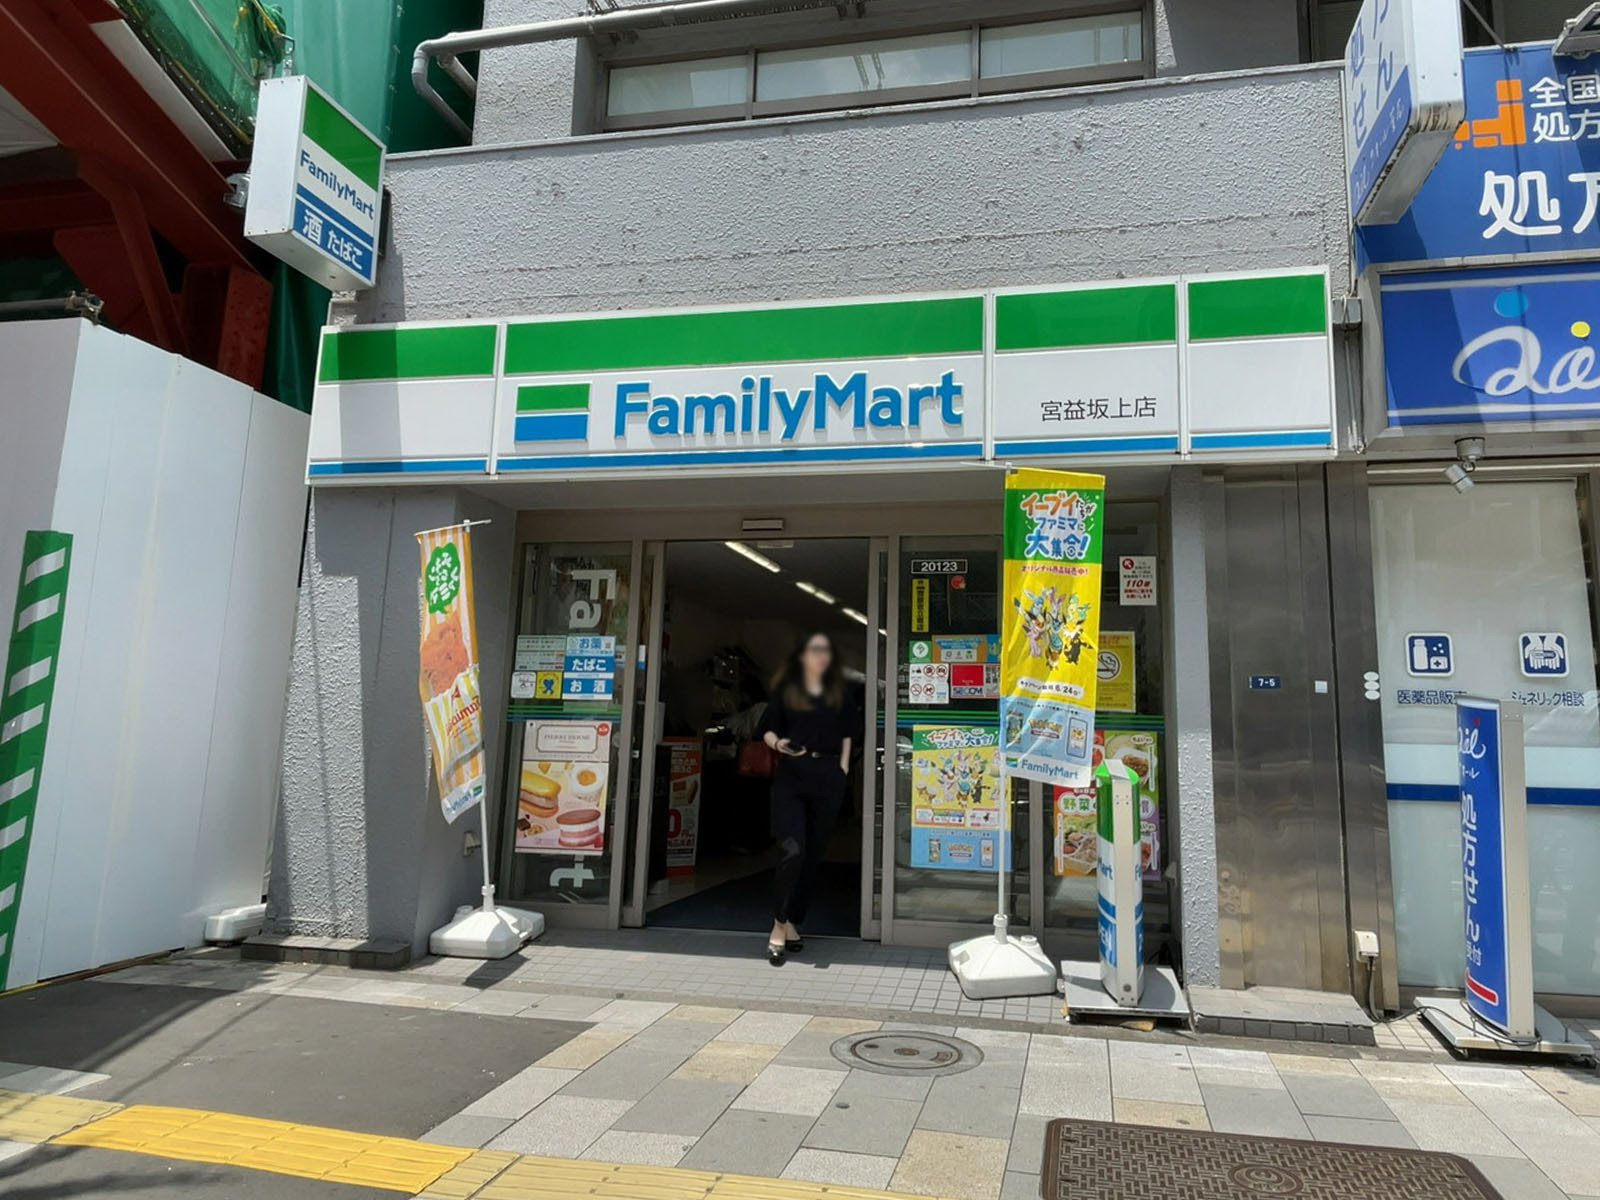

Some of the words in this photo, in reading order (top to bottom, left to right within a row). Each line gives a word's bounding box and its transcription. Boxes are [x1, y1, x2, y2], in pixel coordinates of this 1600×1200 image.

[300, 150, 375, 221] FamilyMart
[302, 209, 324, 246] 酒
[327, 230, 363, 270] たばこ
[614, 369, 964, 441] FamilyMart
[1040, 396, 1158, 422] 宮益坂上店
[920, 561, 958, 572] 20123
[572, 658, 607, 671] たばこ
[1397, 689, 1467, 705] 医薬品販
[1511, 690, 1585, 707] ジェネリック相談
[1021, 759, 1079, 780] FamilyMart
